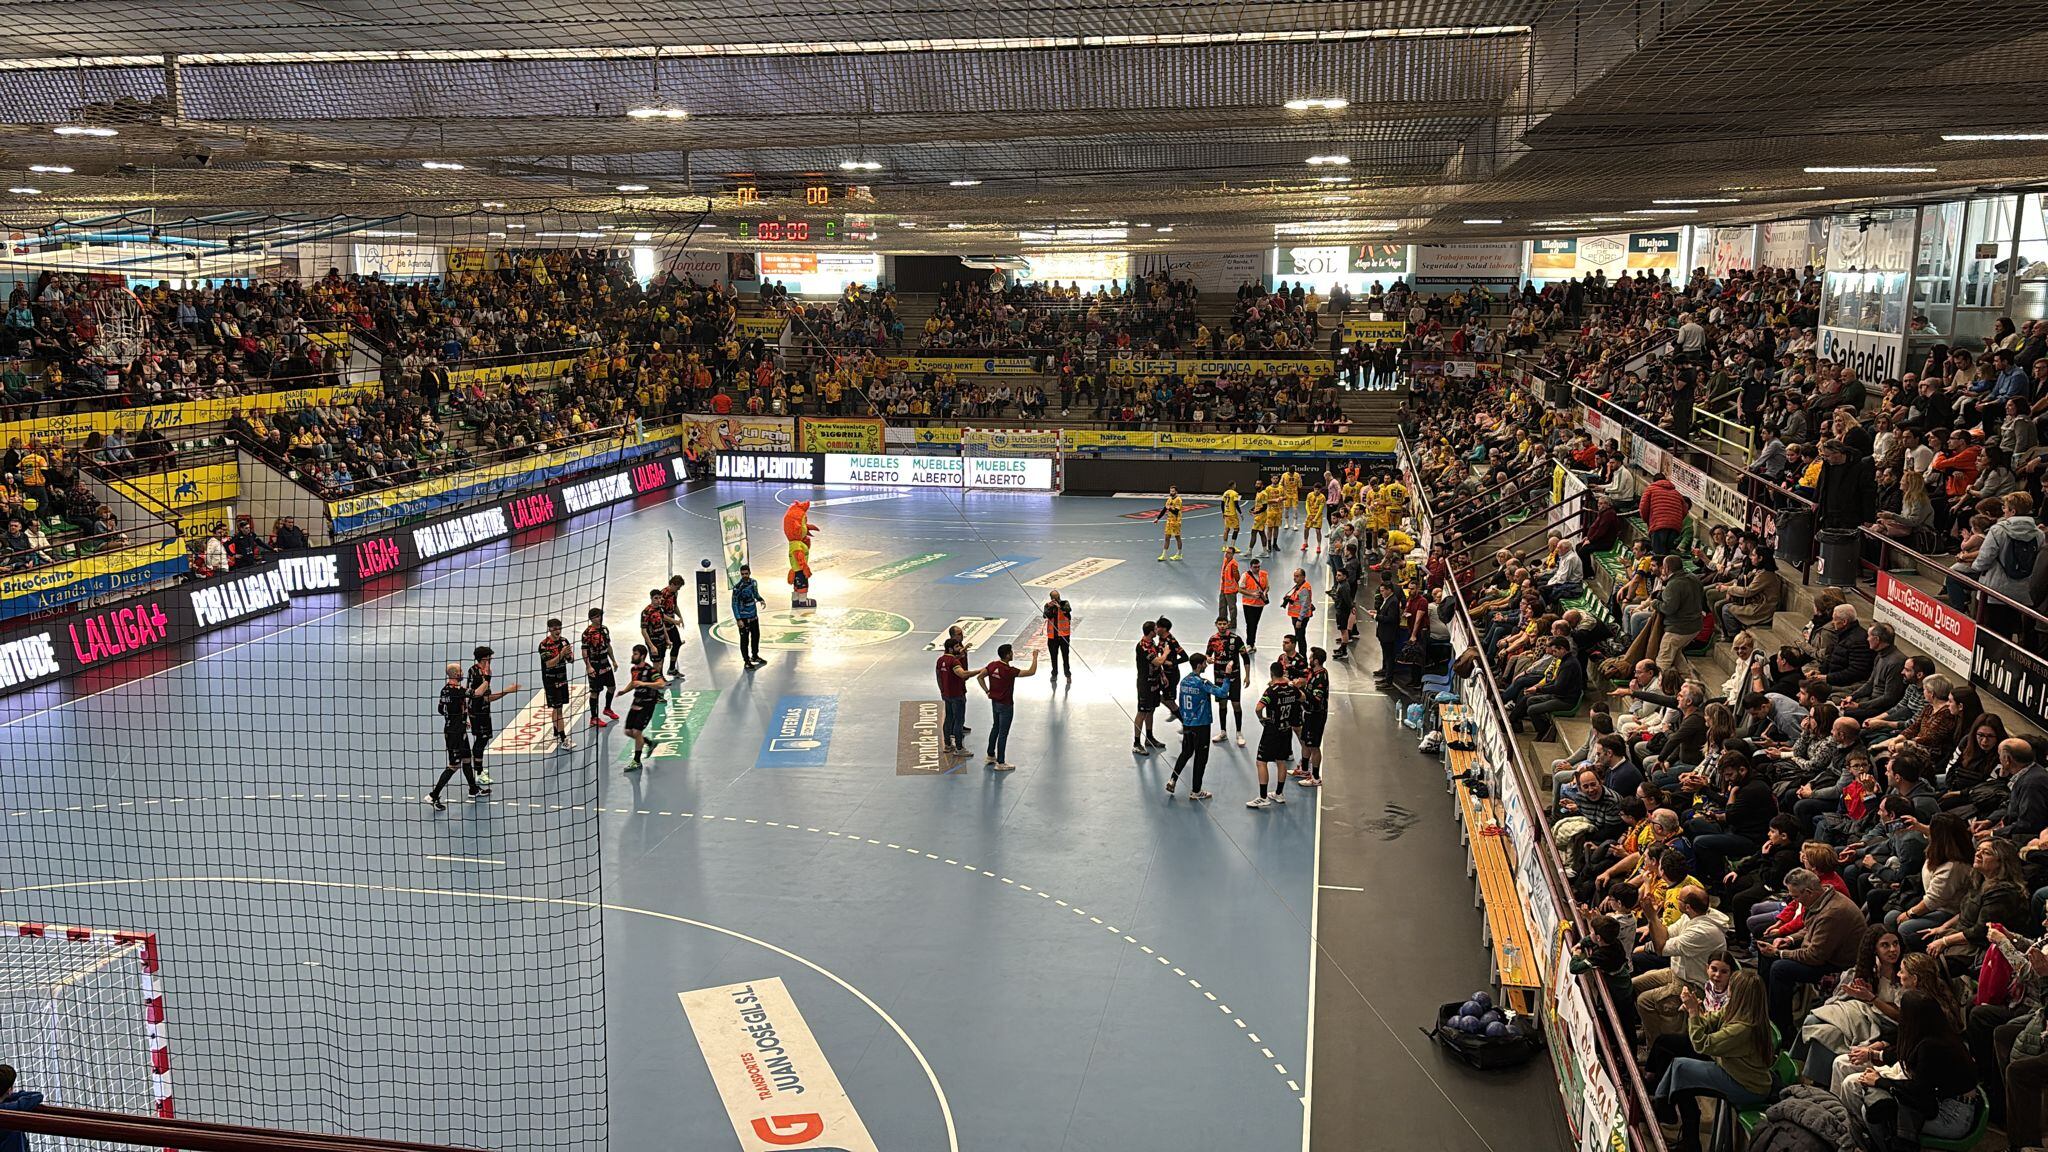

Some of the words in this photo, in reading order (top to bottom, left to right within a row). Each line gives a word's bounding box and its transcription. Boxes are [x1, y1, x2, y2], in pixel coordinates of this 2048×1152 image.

[1638, 238, 1669, 248] Mahou
[1294, 257, 1338, 274] SOL
[1422, 262, 1458, 270] Seguridad
[1831, 338, 1896, 384] Sabadell
[30, 427, 65, 438] DREAM
[67, 425, 93, 434] TEAM
[1243, 437, 1273, 445] Riegos
[1277, 437, 1312, 445] Aranda
[716, 455, 729, 477] LA
[731, 455, 755, 478] LIGA
[757, 456, 813, 479] PLENITUDE
[850, 457, 899, 469] MUEBLES
[912, 459, 962, 471] MUEBLES
[975, 461, 1026, 472] MUEBLES
[632, 462, 666, 493] LALIGA+
[850, 471, 899, 482] ALBERTO
[912, 473, 961, 484] ALBERTO
[975, 474, 1026, 485] ALBERTO
[403, 501, 427, 513] Duero
[413, 524, 436, 560] POR
[433, 521, 449, 554] LA
[444, 517, 468, 552] LIGA
[463, 506, 509, 545] PLENITUDE
[3, 570, 74, 593] BricoCentro
[38, 585, 87, 609] Aranda
[93, 581, 104, 590] de
[111, 569, 151, 588] Duero
[190, 586, 227, 627] POR
[220, 579, 243, 618] LA
[238, 570, 272, 612] LIGA
[1973, 644, 2012, 695] Mesón
[2017, 671, 2033, 708] de
[1183, 695, 1193, 710] 16
[1280, 705, 1292, 719] 23
[913, 703, 938, 729] Duero
[911, 741, 940, 772] Aranda
[731, 985, 758, 1005] S.L.
[740, 1003, 767, 1024] GIL
[741, 1023, 785, 1053] JOSÉ
[741, 1052, 773, 1101] TRANSPORTES
[765, 1055, 805, 1095] JUAN
